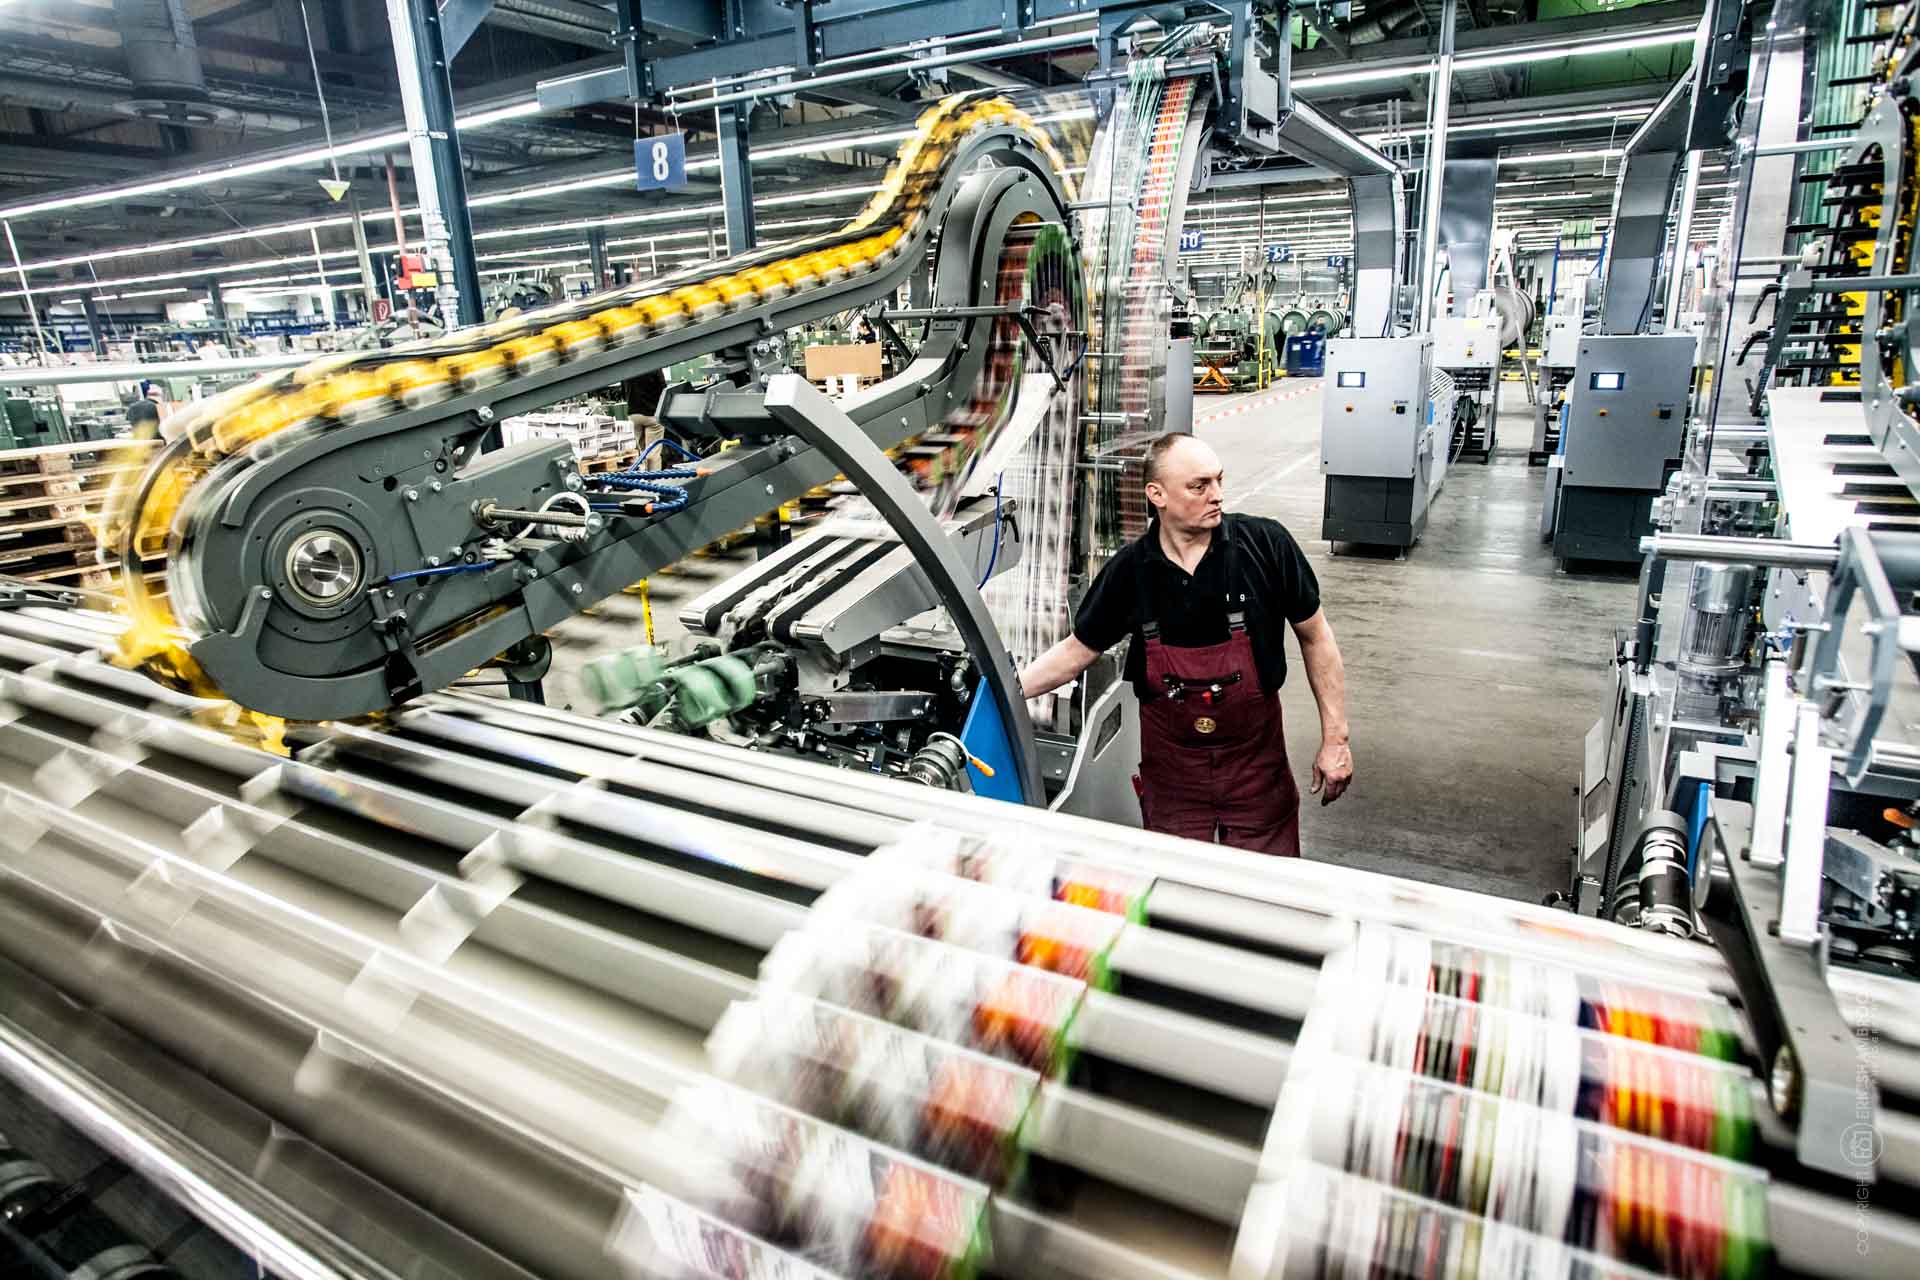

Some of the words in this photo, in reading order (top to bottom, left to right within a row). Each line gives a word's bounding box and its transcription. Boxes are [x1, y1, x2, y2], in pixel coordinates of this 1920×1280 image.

[652, 142, 669, 180] 8
[1182, 231, 1199, 248] 10
[1331, 255, 1343, 266] 12
